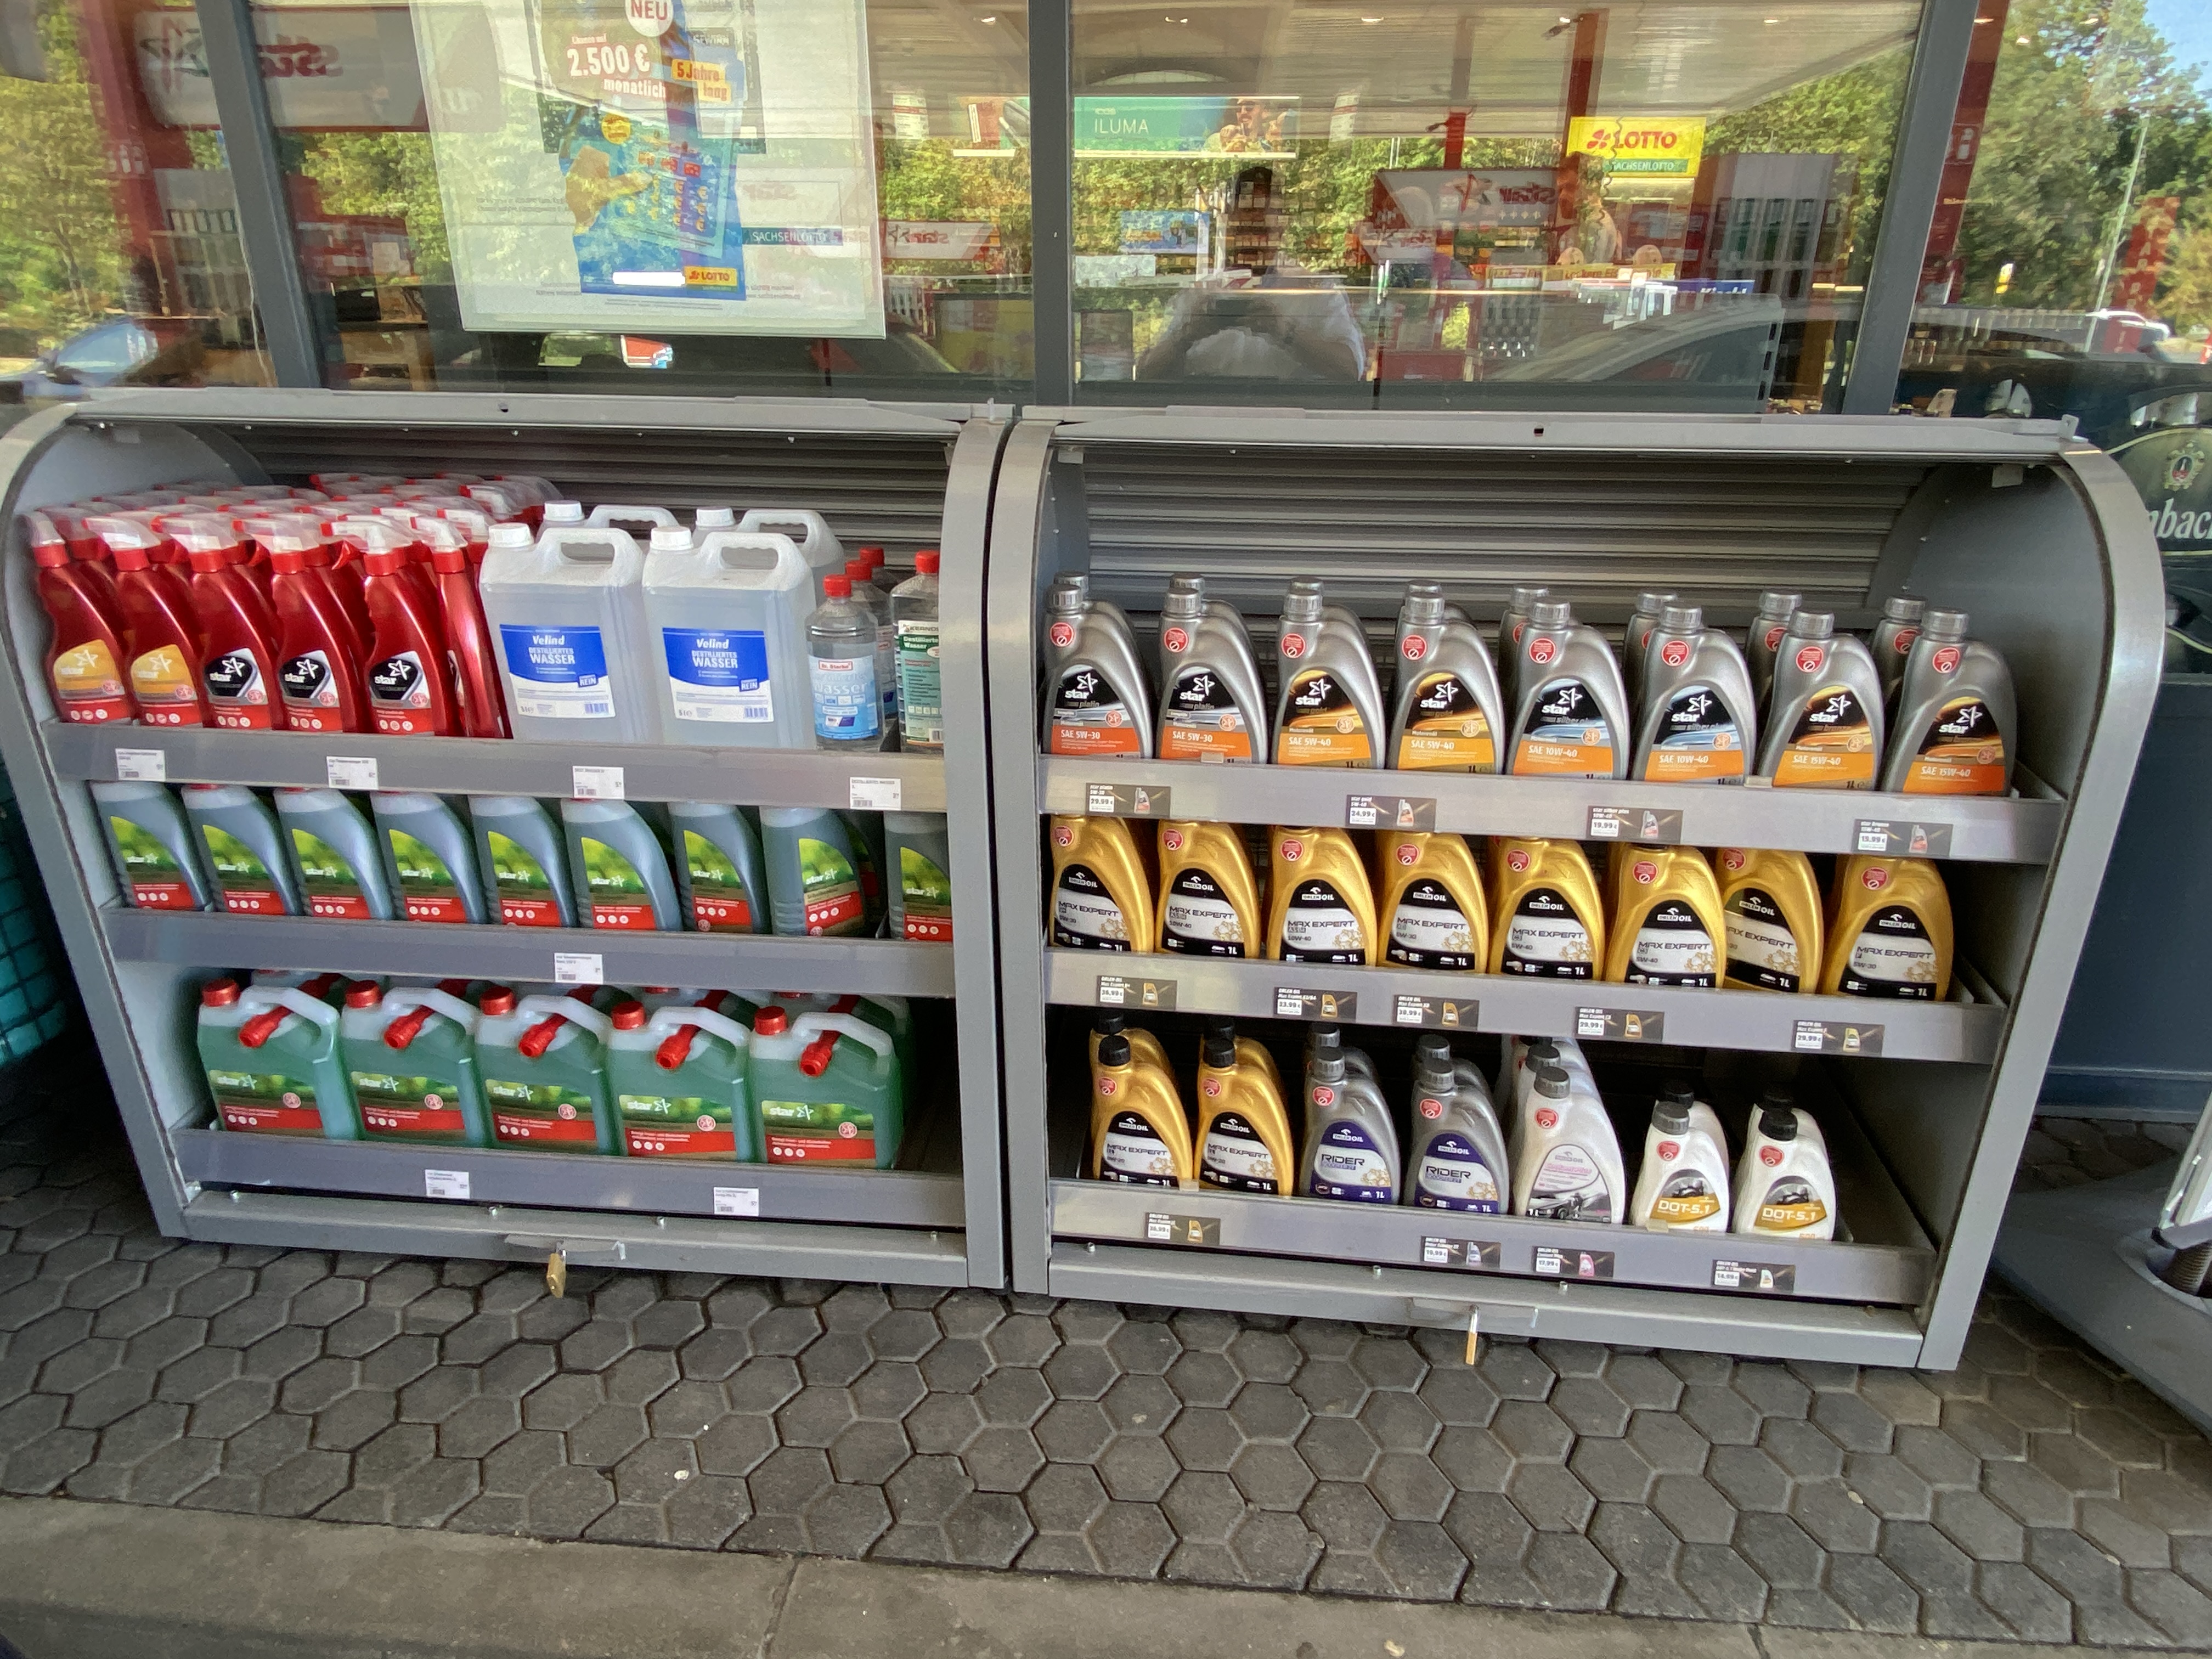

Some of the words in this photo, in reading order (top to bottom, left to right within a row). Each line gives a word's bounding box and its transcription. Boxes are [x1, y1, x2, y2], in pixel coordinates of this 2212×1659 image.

[630, 0, 668, 20] NEU
[567, 46, 630, 76] 2.500
[634, 43, 650, 72] €
[677, 62, 685, 78] 5
[686, 63, 720, 81] Jahre
[603, 78, 667, 98] monatlich
[703, 82, 727, 101] lang
[1094, 118, 1149, 134] ILUMA
[1613, 131, 1678, 149] LOTTO
[752, 230, 827, 242] SACHSENLOTTO
[701, 272, 730, 281] LOTTO
[2149, 497, 2212, 540] bac
[530, 653, 575, 665] WASSER
[692, 657, 738, 668] WASSER
[284, 673, 306, 684] star
[375, 674, 397, 685] star
[1065, 689, 1090, 700] star
[1180, 691, 1206, 702] star
[1295, 695, 1322, 707] star
[1420, 697, 1448, 709] star
[1542, 703, 1570, 716] star
[1671, 710, 1700, 723] star
[1809, 712, 1838, 724] star
[1060, 730, 1075, 739] SAE
[1076, 730, 1101, 740] 5W-30
[1938, 723, 1968, 735] star
[1172, 731, 1186, 740] SAE
[1188, 733, 1213, 743] 5W-30
[1289, 737, 1302, 746] SAE
[1304, 737, 1331, 747] 5W-40
[1410, 739, 1425, 748] SAE
[1427, 741, 1455, 750] 5W-40
[1528, 745, 1544, 755] SAE
[1545, 747, 1578, 758] 10W-40
[1659, 755, 1674, 764] SAE
[1677, 755, 1709, 764] 10W-40
[1793, 754, 1809, 764] SAE
[1810, 755, 1842, 766] 15W-40
[1921, 766, 1937, 775] SAE
[1939, 768, 1971, 777] 15W-40
[693, 869, 711, 879] star
[805, 873, 826, 885] star
[905, 887, 926, 896] star
[1058, 901, 1077, 911] MAX
[1079, 906, 1119, 917] EXPERT
[1169, 906, 1191, 915] MAX
[1192, 910, 1234, 919] EXPERT
[1760, 906, 1775, 916] OIL
[1397, 917, 1420, 926] MAX
[1421, 921, 1466, 930] EXPERT
[1513, 928, 1537, 936] MAX
[1538, 930, 1584, 939] EXPERT
[1726, 926, 1744, 937] AX
[1745, 932, 1795, 949] EXPERT
[1114, 944, 1123, 952] 1L
[1228, 946, 1237, 955] 1L
[1638, 941, 1664, 950] MAX
[1664, 943, 1711, 951] EXPERT
[1348, 953, 1358, 962] 1L
[1857, 946, 1883, 956] MAX
[1884, 949, 1933, 960] EXPERT
[1457, 957, 1468, 966] 1L
[1575, 967, 1585, 975] 1L
[1699, 978, 1708, 986] 1L
[1779, 977, 1790, 988] 1L
[1917, 987, 1928, 996] 1L
[493, 1085, 518, 1097] star
[627, 1099, 653, 1112] star
[769, 1105, 795, 1118] star
[1107, 1143, 1127, 1152] MAX
[1128, 1147, 1168, 1156] EXPERT
[1207, 1143, 1228, 1153] MAX
[1229, 1147, 1269, 1159] EXPERT
[1322, 1153, 1365, 1166] RIDER
[1426, 1165, 1471, 1180] RIDER
[1262, 1182, 1272, 1190] 1L
[1375, 1190, 1385, 1199] 1L
[1482, 1204, 1492, 1213] 1L
[1658, 1200, 1711, 1215] DOT-5.1
[1762, 1207, 1816, 1222] DOT-5.1
